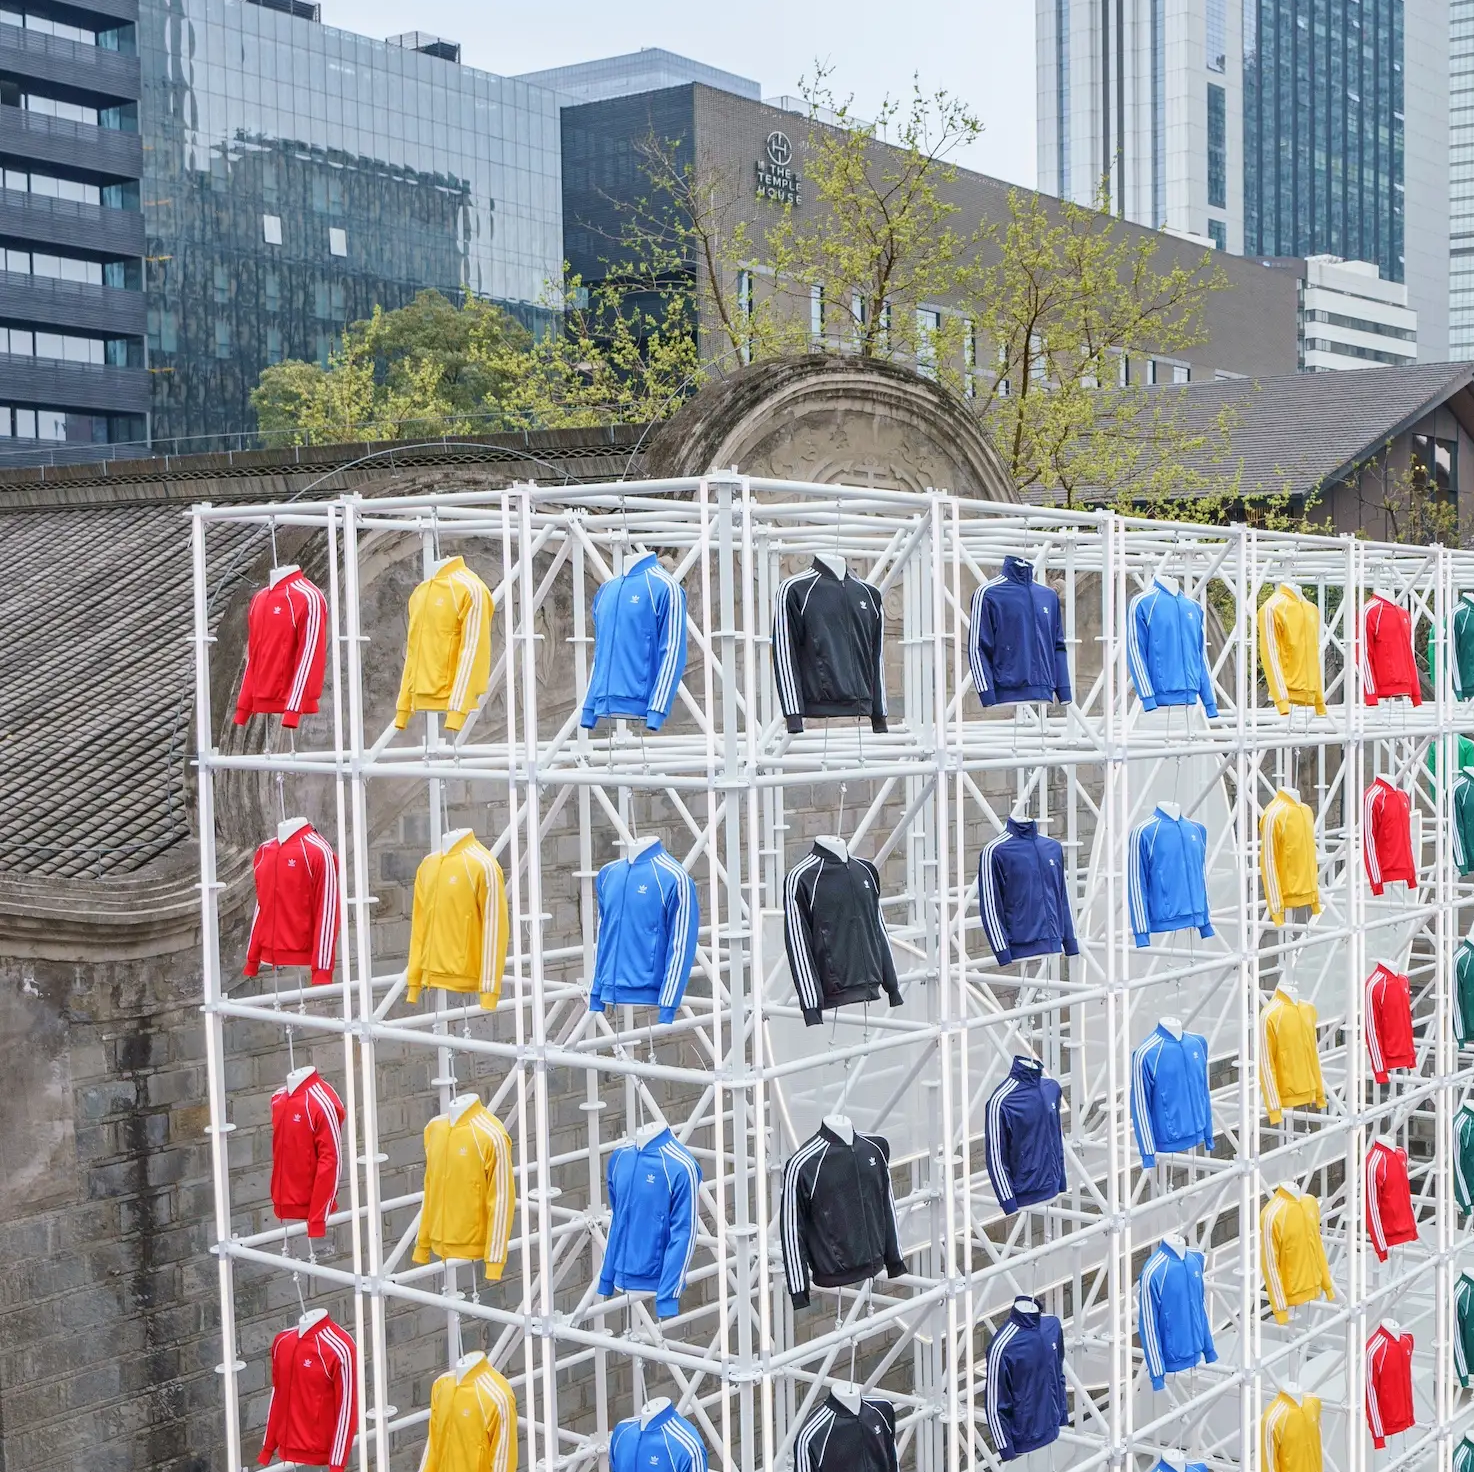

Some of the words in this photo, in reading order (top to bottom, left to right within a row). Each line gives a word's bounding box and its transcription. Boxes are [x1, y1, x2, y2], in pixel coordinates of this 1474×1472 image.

[770, 164, 791, 180] THE
[758, 172, 802, 193] TEMPLE
[758, 185, 802, 205] HOUSE
